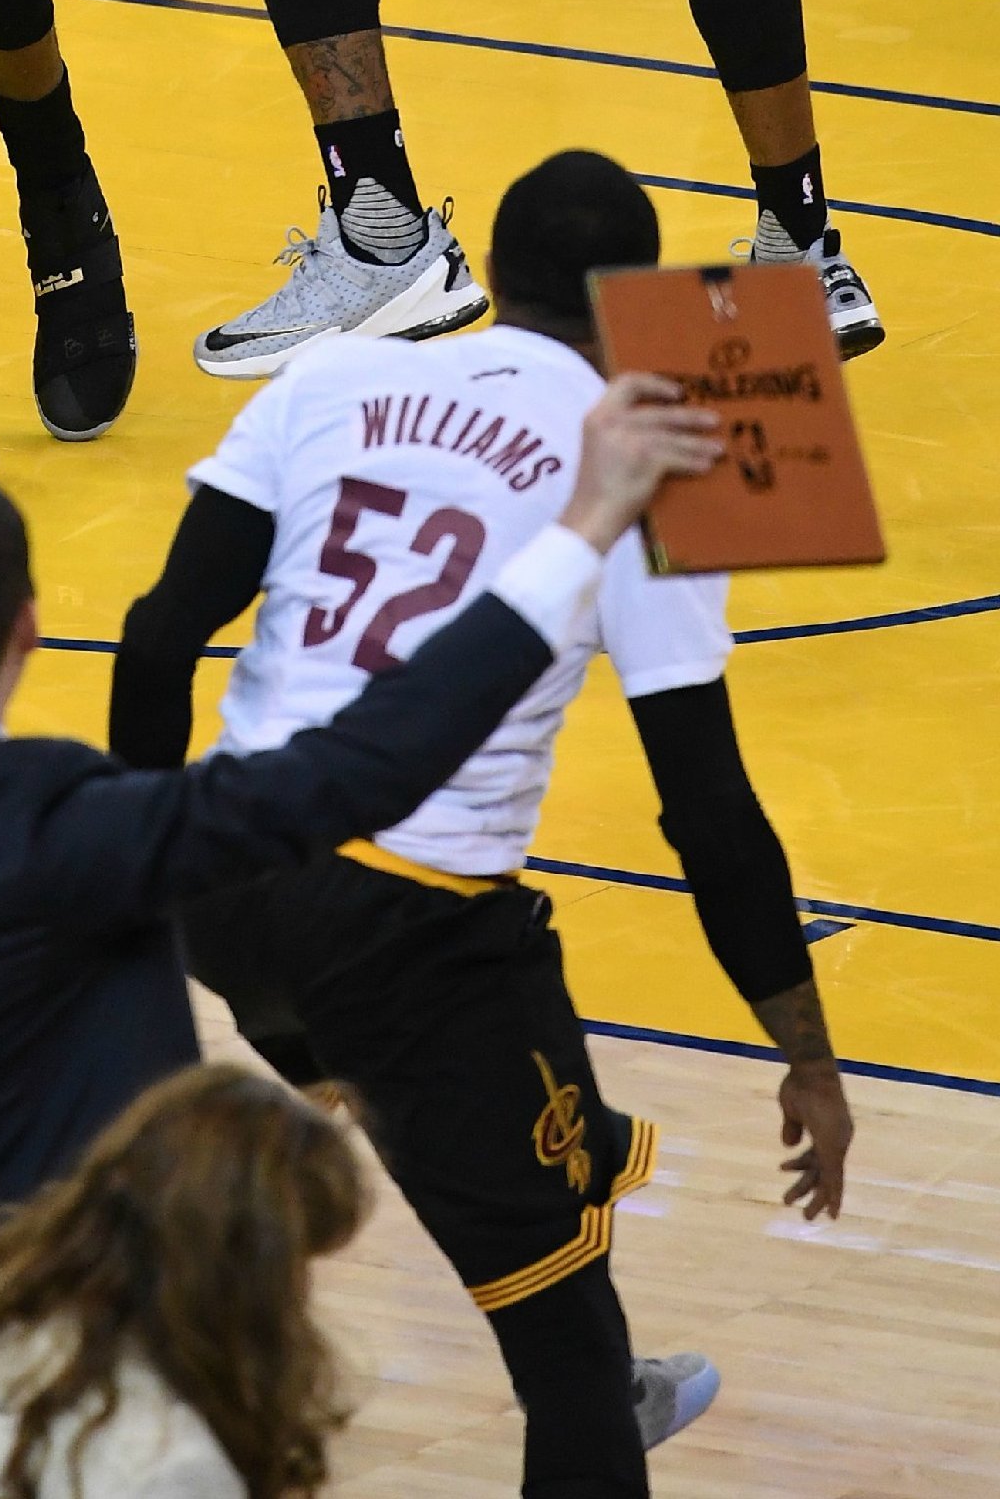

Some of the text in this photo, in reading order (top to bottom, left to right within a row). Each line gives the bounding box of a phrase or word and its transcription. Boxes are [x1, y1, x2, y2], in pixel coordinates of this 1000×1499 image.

[682, 363, 822, 403] PALDING
[361, 394, 563, 492] WILLIAMS
[302, 476, 488, 673] 52
